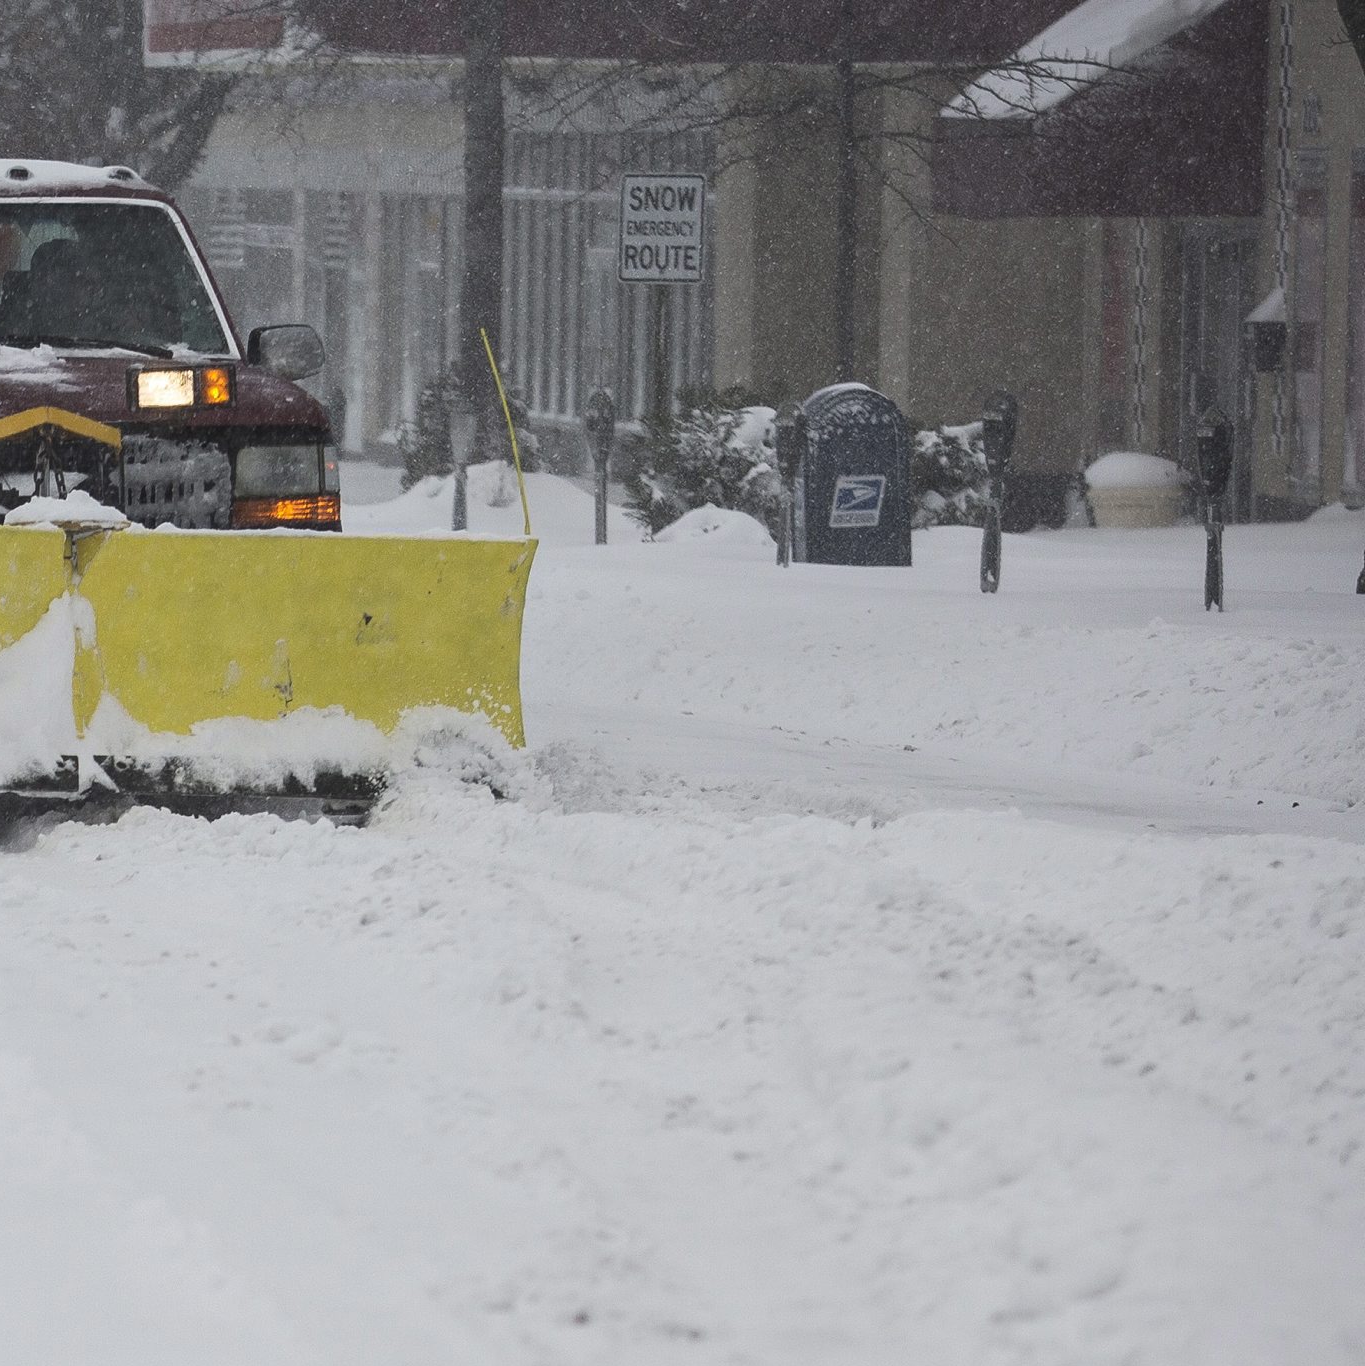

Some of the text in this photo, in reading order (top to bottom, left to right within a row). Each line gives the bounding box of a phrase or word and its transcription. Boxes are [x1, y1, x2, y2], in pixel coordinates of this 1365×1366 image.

[629, 186, 697, 211] SNOW
[626, 220, 696, 237] EMERGENCY
[624, 244, 697, 271] ROUTE
